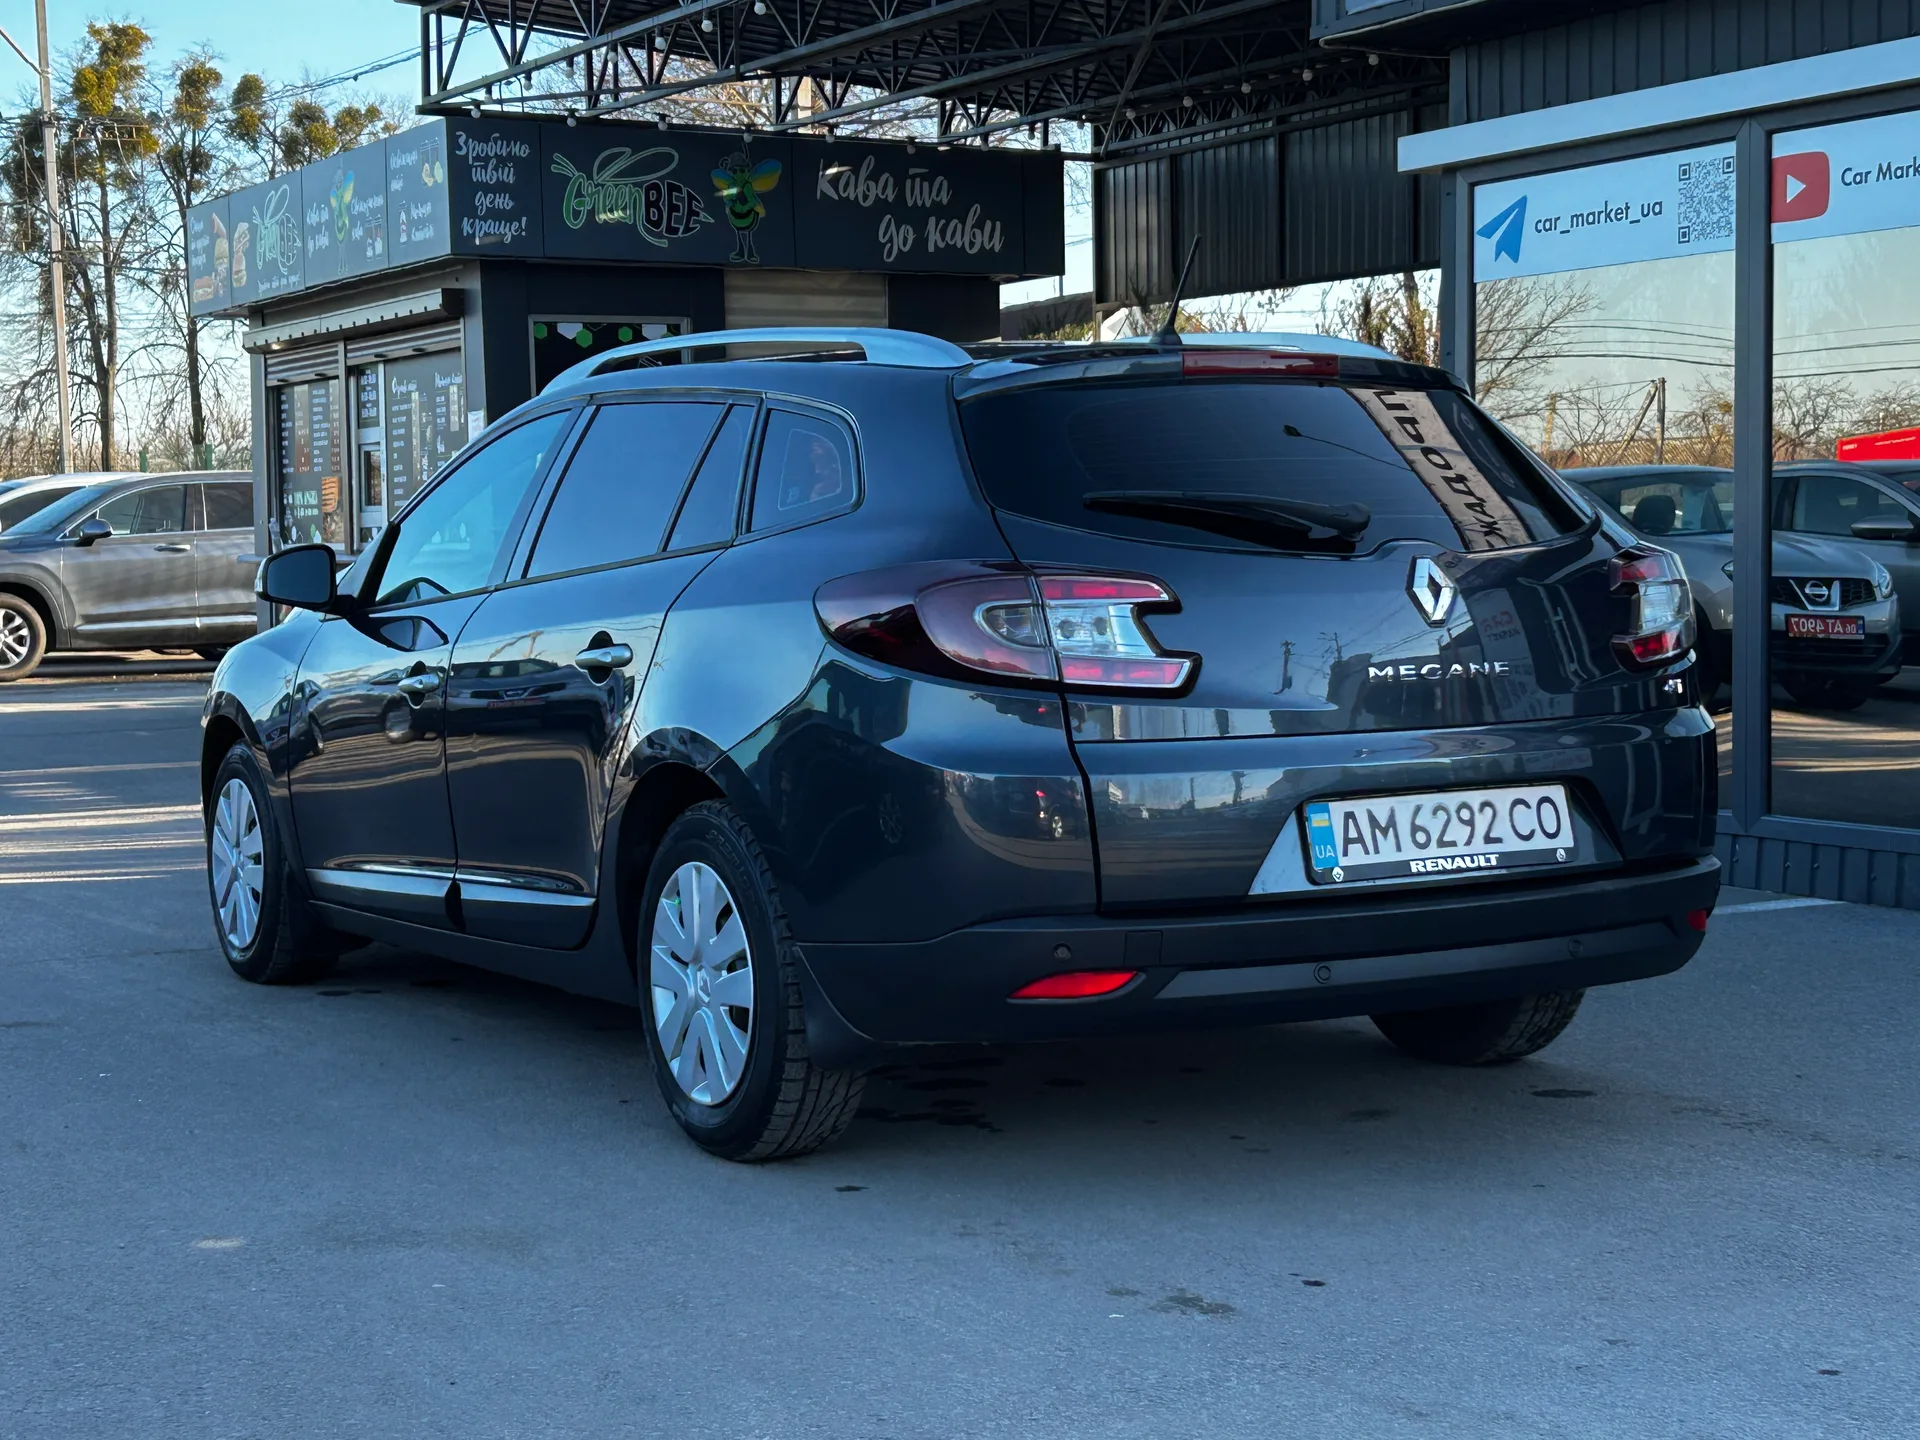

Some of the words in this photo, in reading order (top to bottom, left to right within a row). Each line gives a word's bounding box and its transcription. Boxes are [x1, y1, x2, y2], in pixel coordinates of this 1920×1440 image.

[472, 158, 516, 184] твій
[816, 155, 898, 207] Кава
[905, 167, 951, 208] та
[1841, 167, 1872, 186] Car
[475, 191, 514, 216] день
[1534, 198, 1663, 235] car_market_ua
[879, 213, 916, 262] до
[927, 203, 1004, 254] кави
[1367, 661, 1510, 682] MEGANE
[1316, 844, 1335, 859] UA
[1409, 854, 1499, 873] RENAULT
